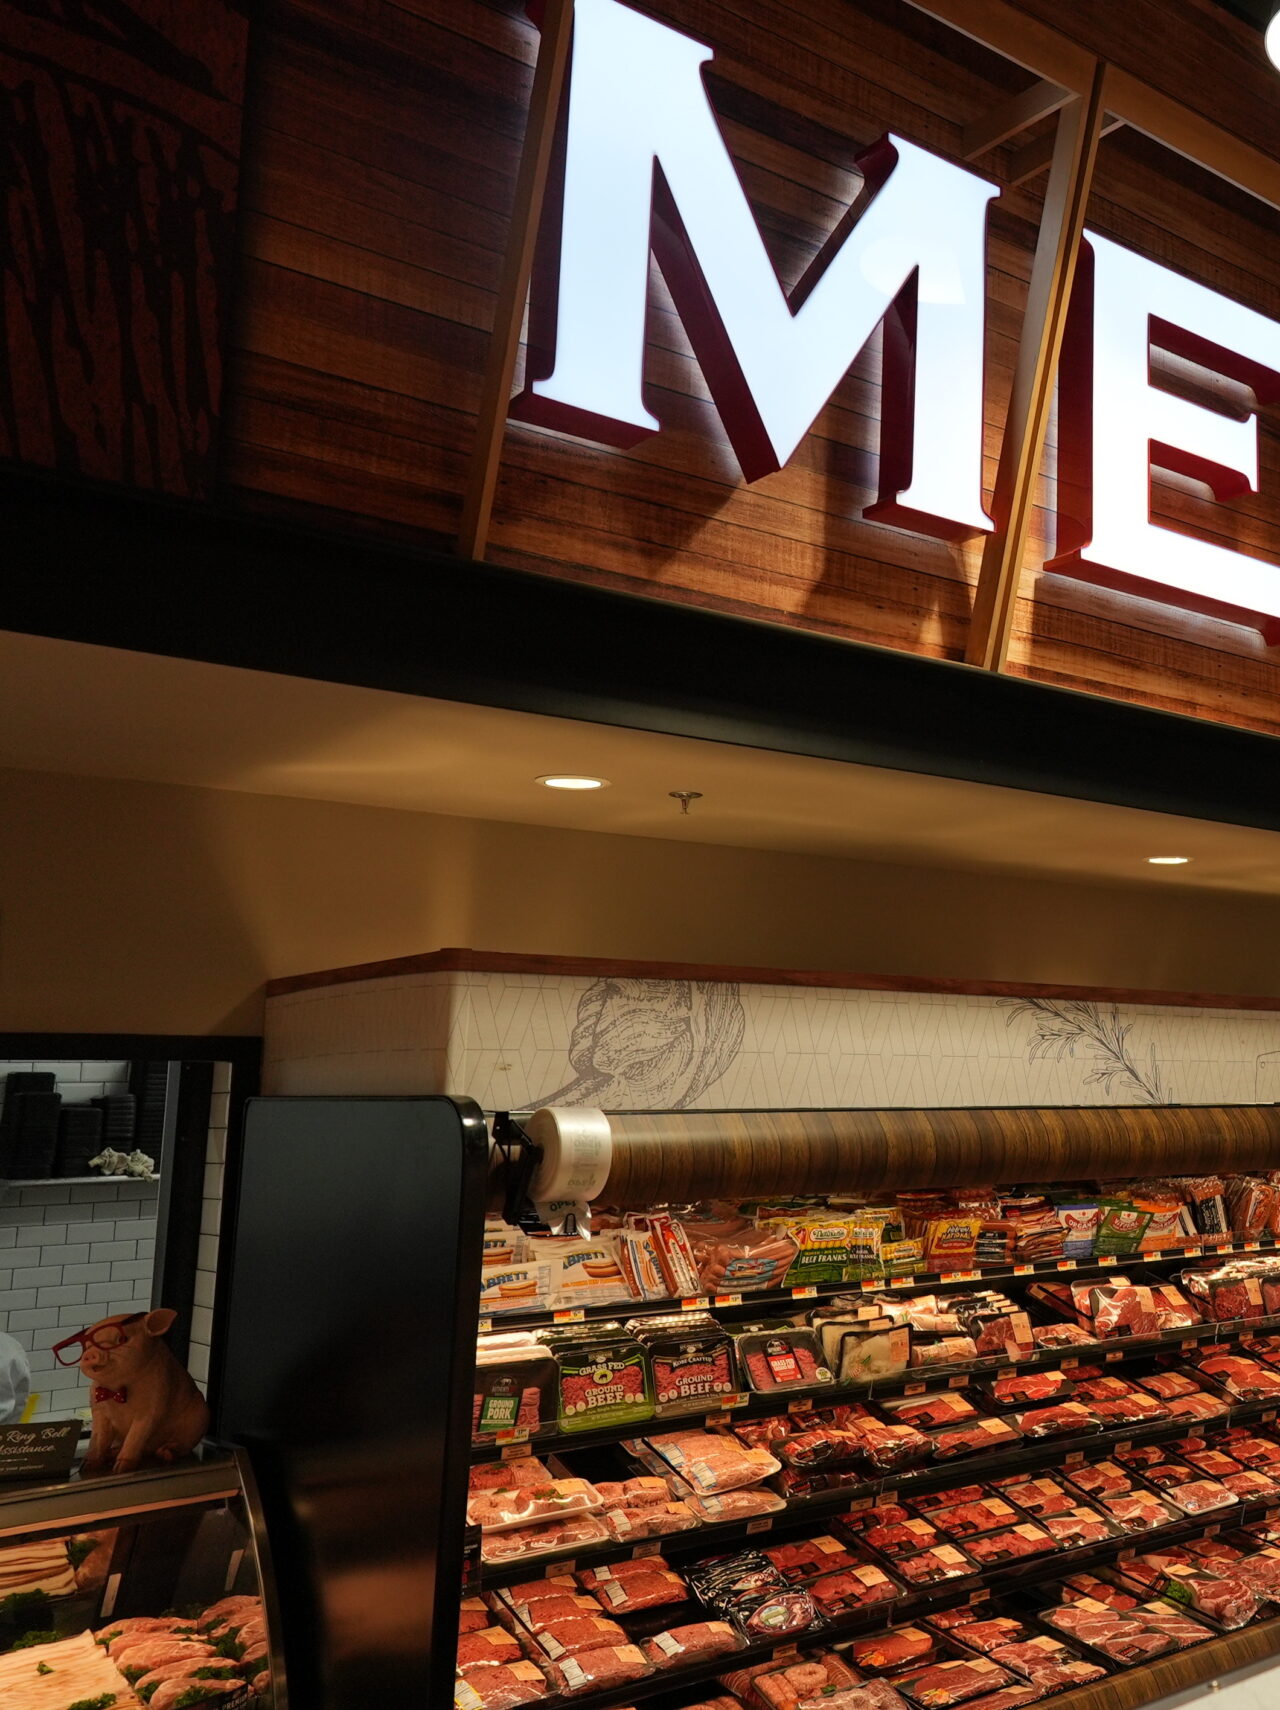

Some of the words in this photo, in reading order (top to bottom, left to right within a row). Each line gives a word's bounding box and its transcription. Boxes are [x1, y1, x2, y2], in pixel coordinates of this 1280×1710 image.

[817, 1252, 848, 1263] FRANKS
[578, 1362, 608, 1376] GRASS
[607, 1361, 625, 1370] FED
[675, 1374, 714, 1386] GROUND
[585, 1384, 625, 1397] GROUND
[680, 1382, 711, 1397] BEEF
[488, 1399, 515, 1408] GROUND
[587, 1392, 624, 1408] BEEF
[486, 1408, 512, 1420] PORK
[6, 1430, 37, 1445] Ring
[41, 1426, 72, 1440] Bell
